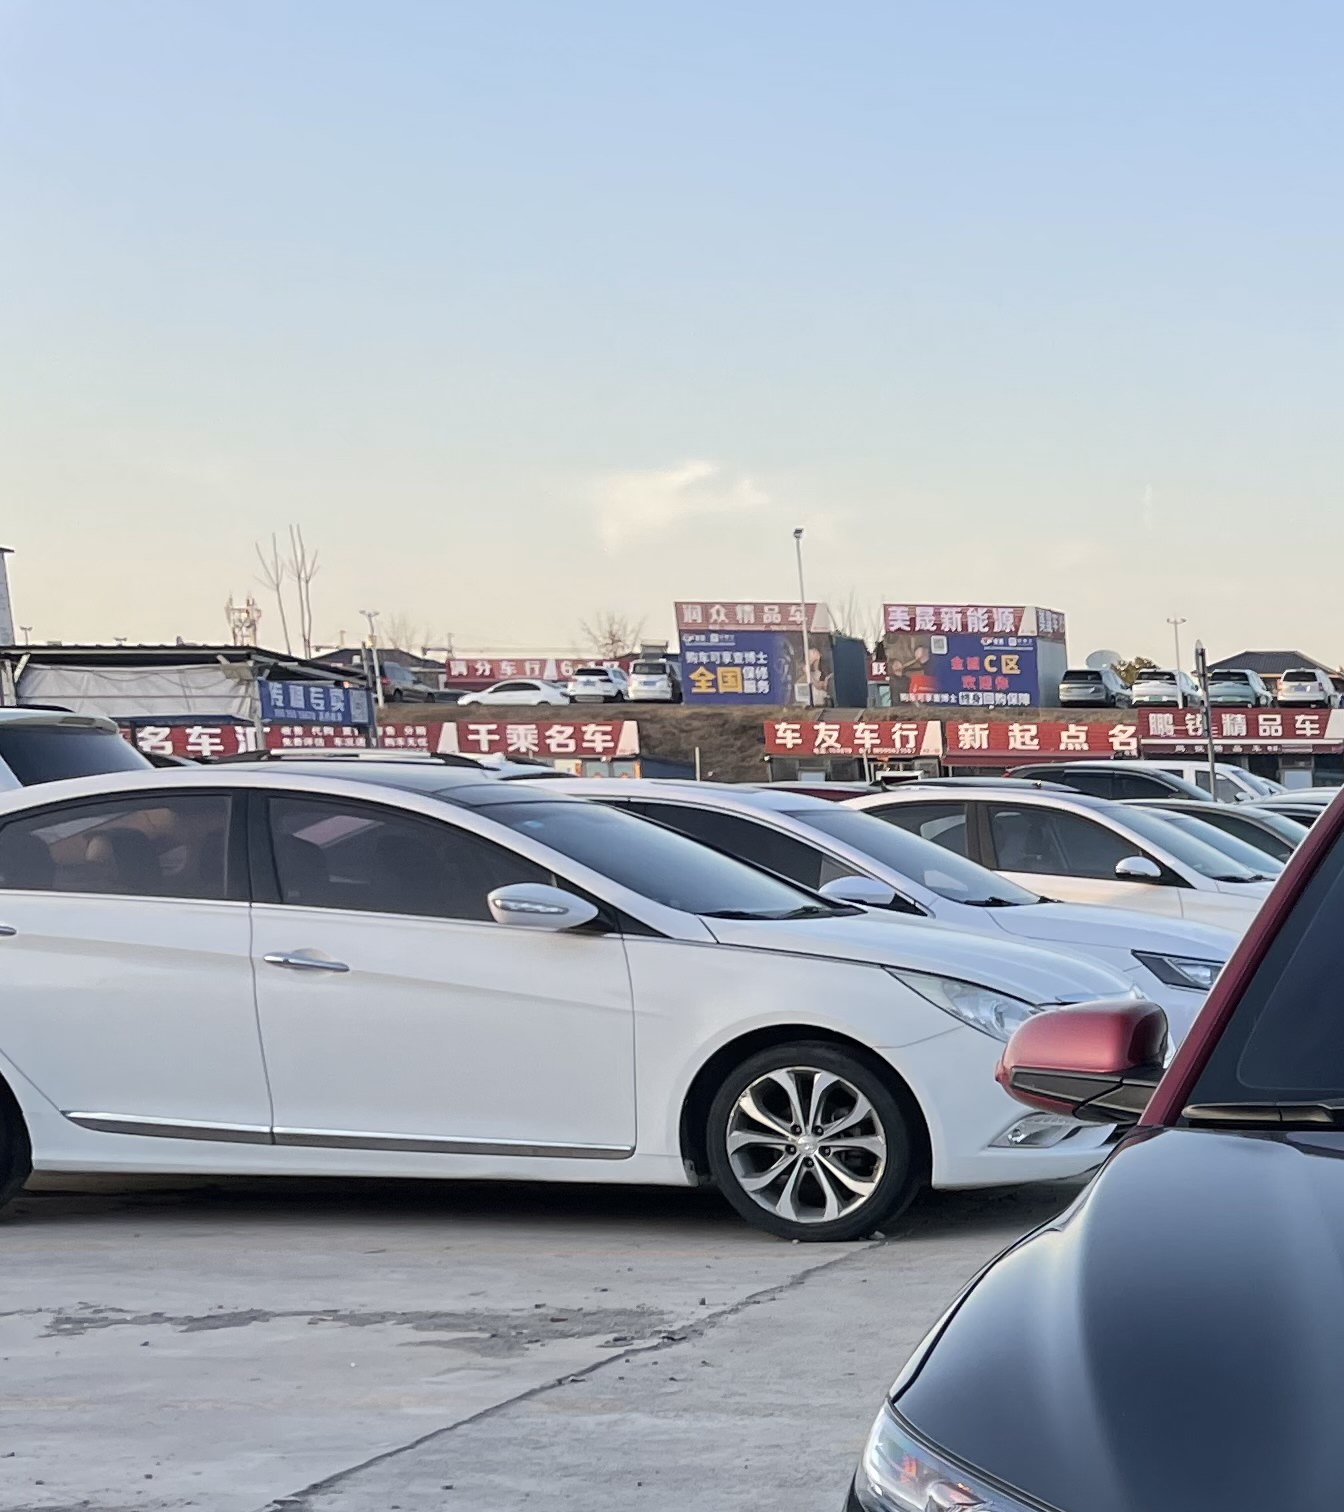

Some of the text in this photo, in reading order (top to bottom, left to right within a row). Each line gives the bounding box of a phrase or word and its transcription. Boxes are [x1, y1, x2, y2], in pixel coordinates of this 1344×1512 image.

[689, 666, 743, 694] 全国
[775, 722, 919, 749] 车友车行
[958, 723, 1138, 751] 新起点名
